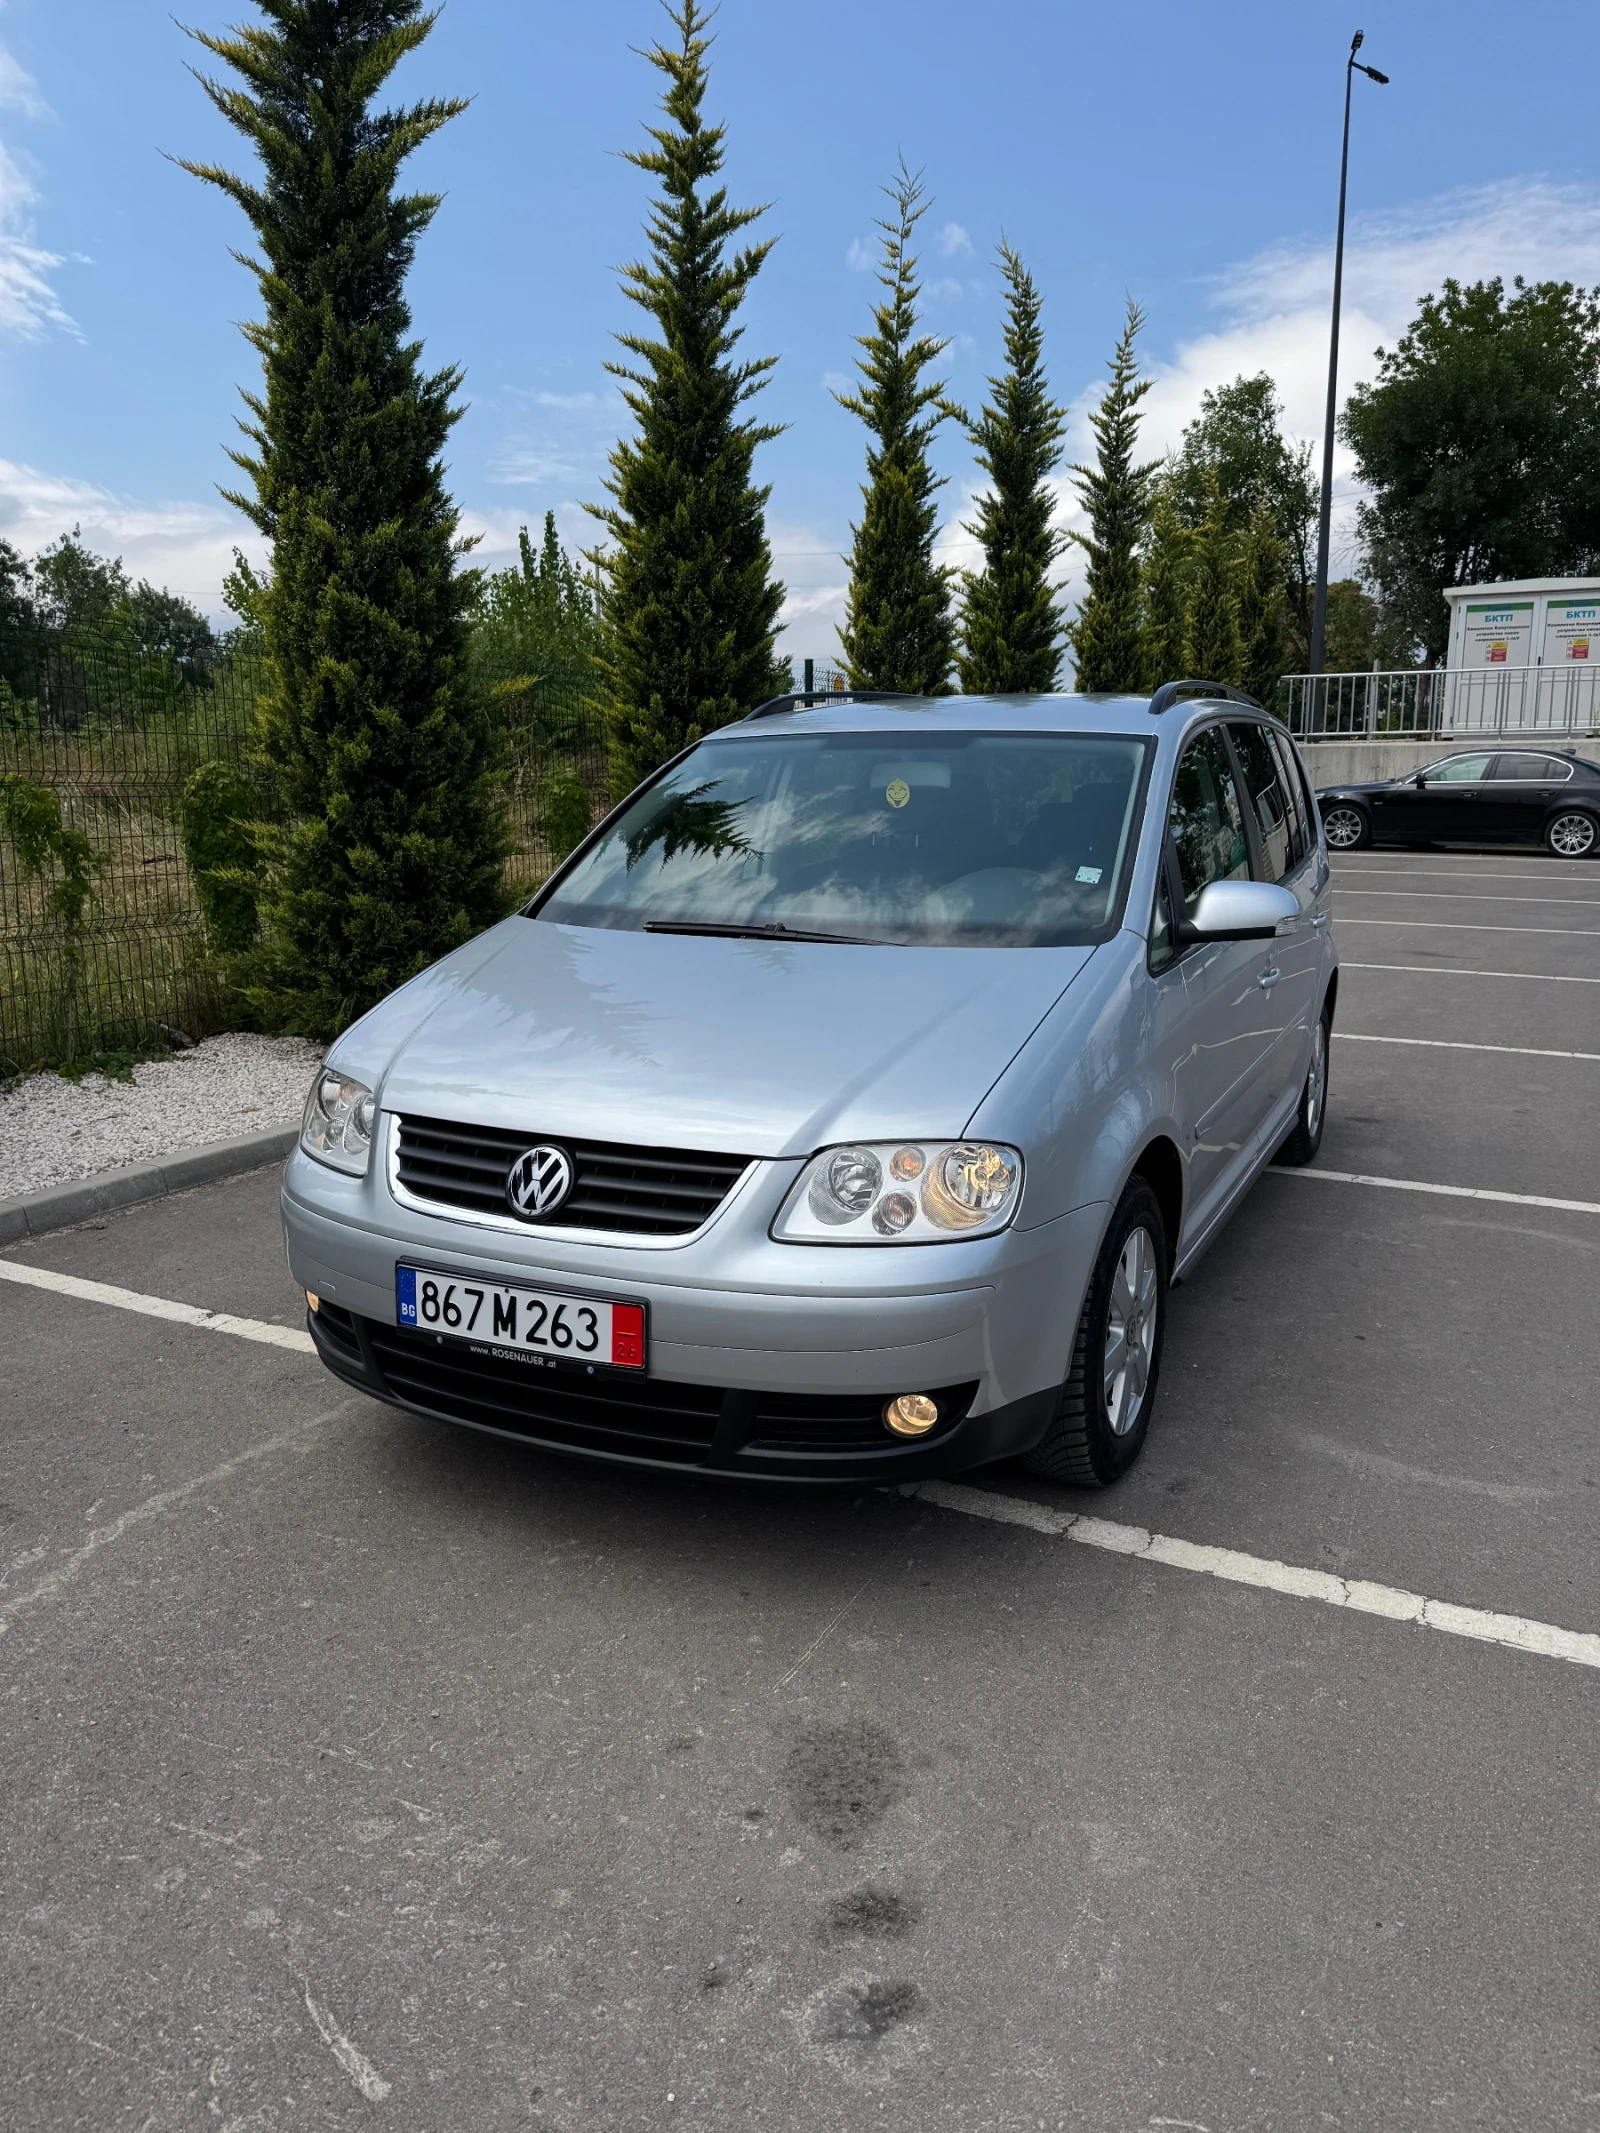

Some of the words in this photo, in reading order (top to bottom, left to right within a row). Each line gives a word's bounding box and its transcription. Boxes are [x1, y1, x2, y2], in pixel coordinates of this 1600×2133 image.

[1485, 614, 1513, 623] БКТП
[1566, 610, 1596, 619] БКТП
[401, 1302, 416, 1318] BG
